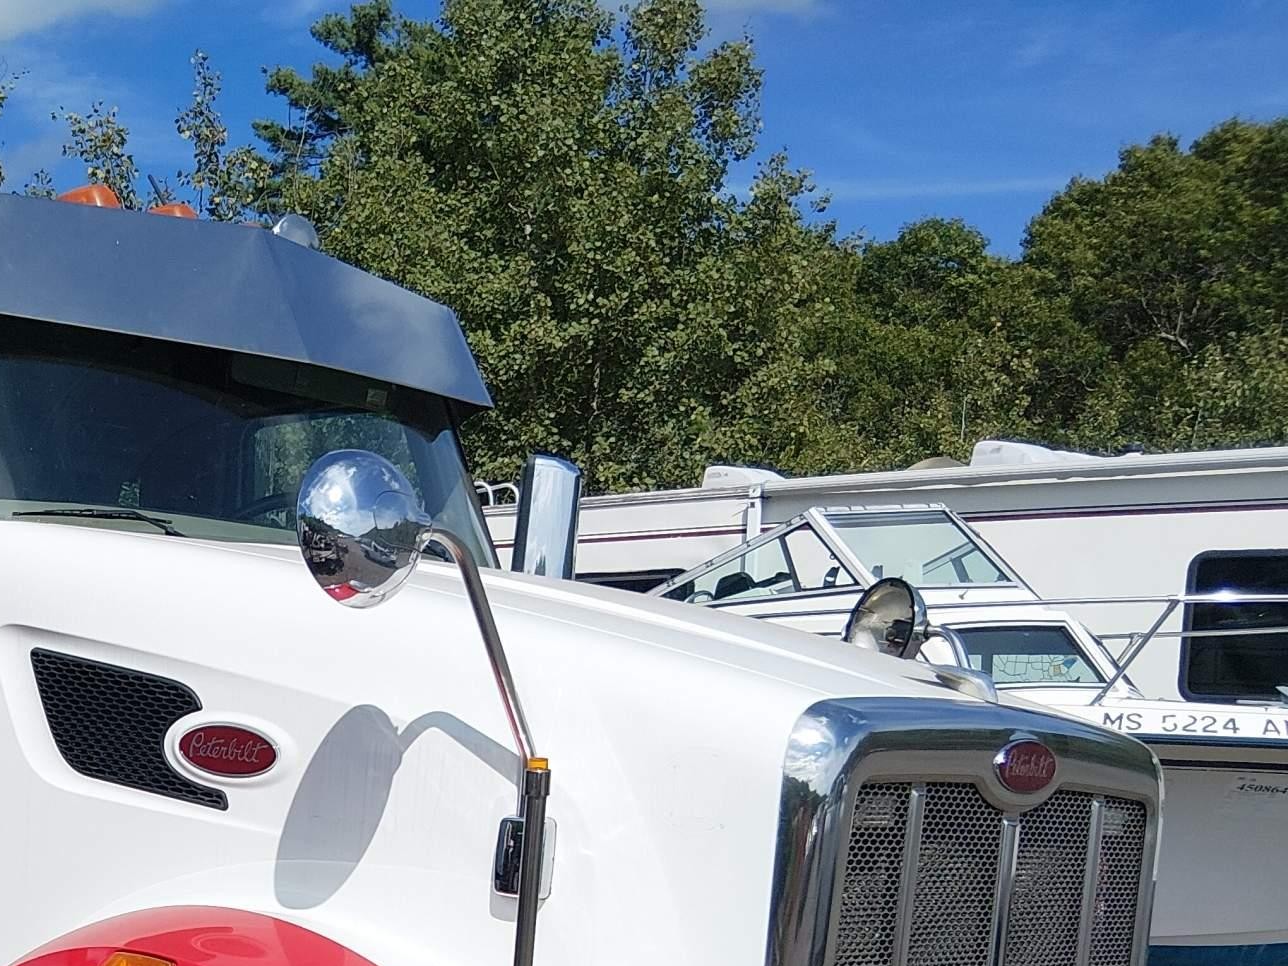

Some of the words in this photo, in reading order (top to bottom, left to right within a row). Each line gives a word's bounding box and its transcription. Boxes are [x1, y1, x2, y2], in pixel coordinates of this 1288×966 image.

[1103, 712, 1143, 731] MS
[1161, 714, 1241, 735] 5224
[1262, 718, 1288, 736] A
[188, 731, 268, 764] Peterbilt
